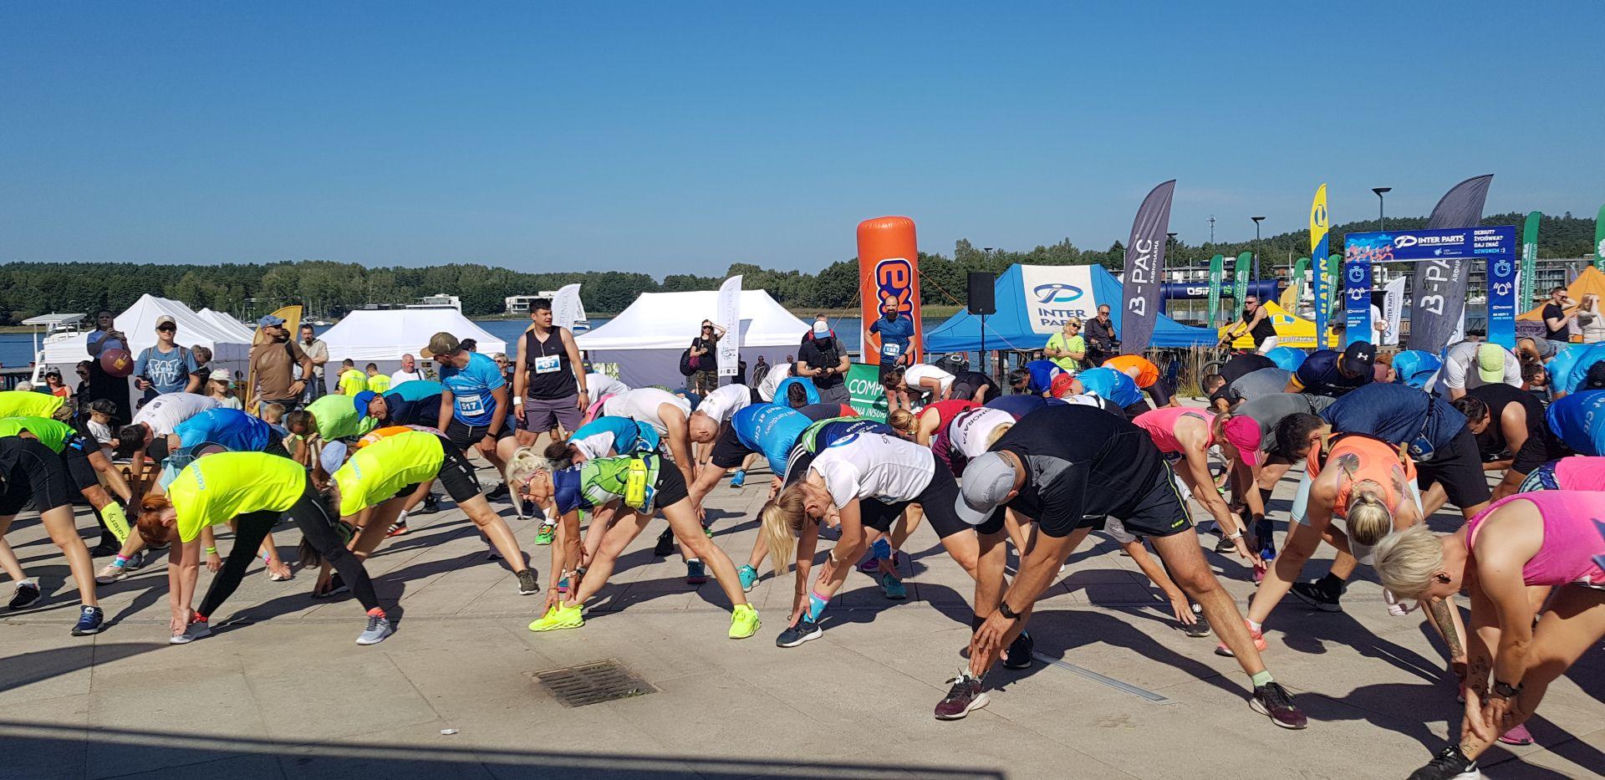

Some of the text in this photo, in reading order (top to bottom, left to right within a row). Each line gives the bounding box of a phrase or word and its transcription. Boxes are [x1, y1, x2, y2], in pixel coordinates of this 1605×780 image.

[1418, 234, 1465, 244] INTER PARTS
[1128, 239, 1152, 317] B-PAC
[1420, 258, 1450, 316] B-PA
[1038, 307, 1088, 318] INTER
[848, 378, 885, 396] COMP
[461, 401, 476, 411] 517
